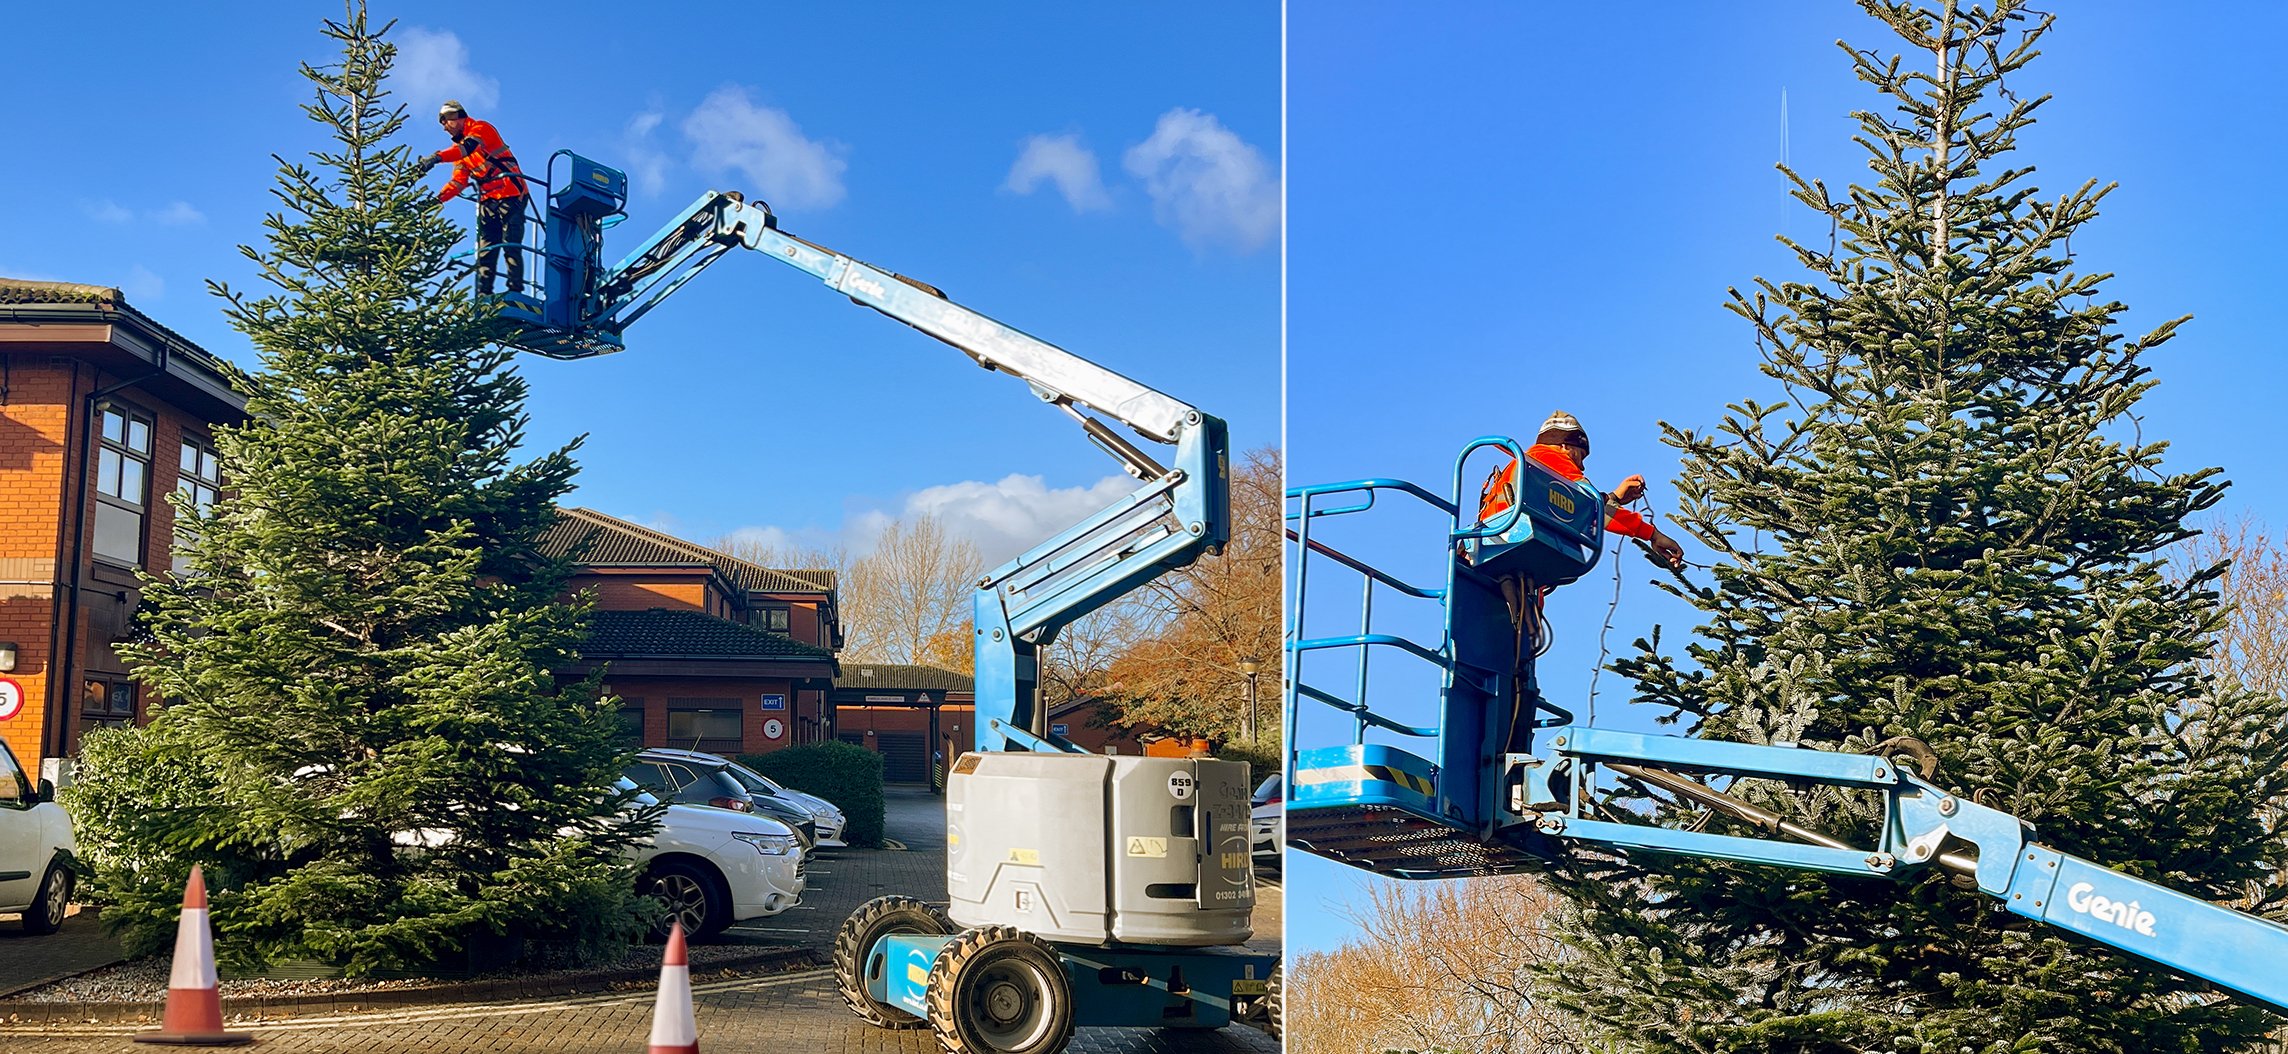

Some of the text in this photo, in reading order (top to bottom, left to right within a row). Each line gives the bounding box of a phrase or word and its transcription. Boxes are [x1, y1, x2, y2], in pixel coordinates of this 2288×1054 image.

[1549, 488, 1575, 514] HIRD
[770, 724, 777, 733] 5
[1171, 778, 1192, 786] 859
[1220, 823, 1237, 832] HIRE
[1221, 852, 1249, 869] HIRD
[1215, 890, 1236, 900] 01302
[2067, 881, 2157, 938] Genie
